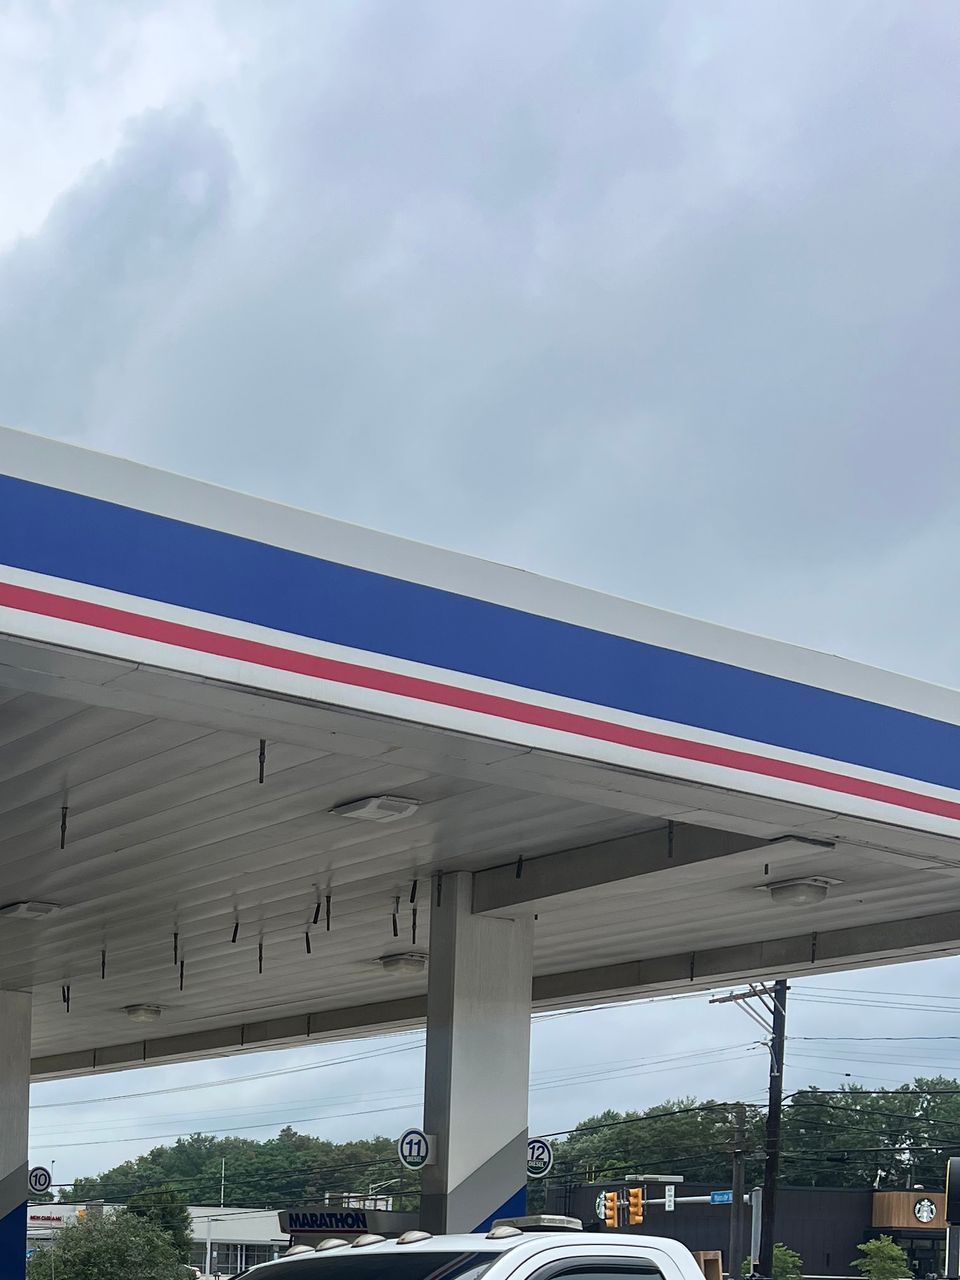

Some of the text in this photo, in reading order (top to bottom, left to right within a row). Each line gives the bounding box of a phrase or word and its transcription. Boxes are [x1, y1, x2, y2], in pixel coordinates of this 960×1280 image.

[404, 1138, 423, 1157] 11
[529, 1143, 546, 1161] 12
[406, 1155, 423, 1163] DIESEL
[527, 1160, 545, 1168] DIESEL
[32, 1173, 47, 1187] 10
[289, 1212, 368, 1229] MARATHON
